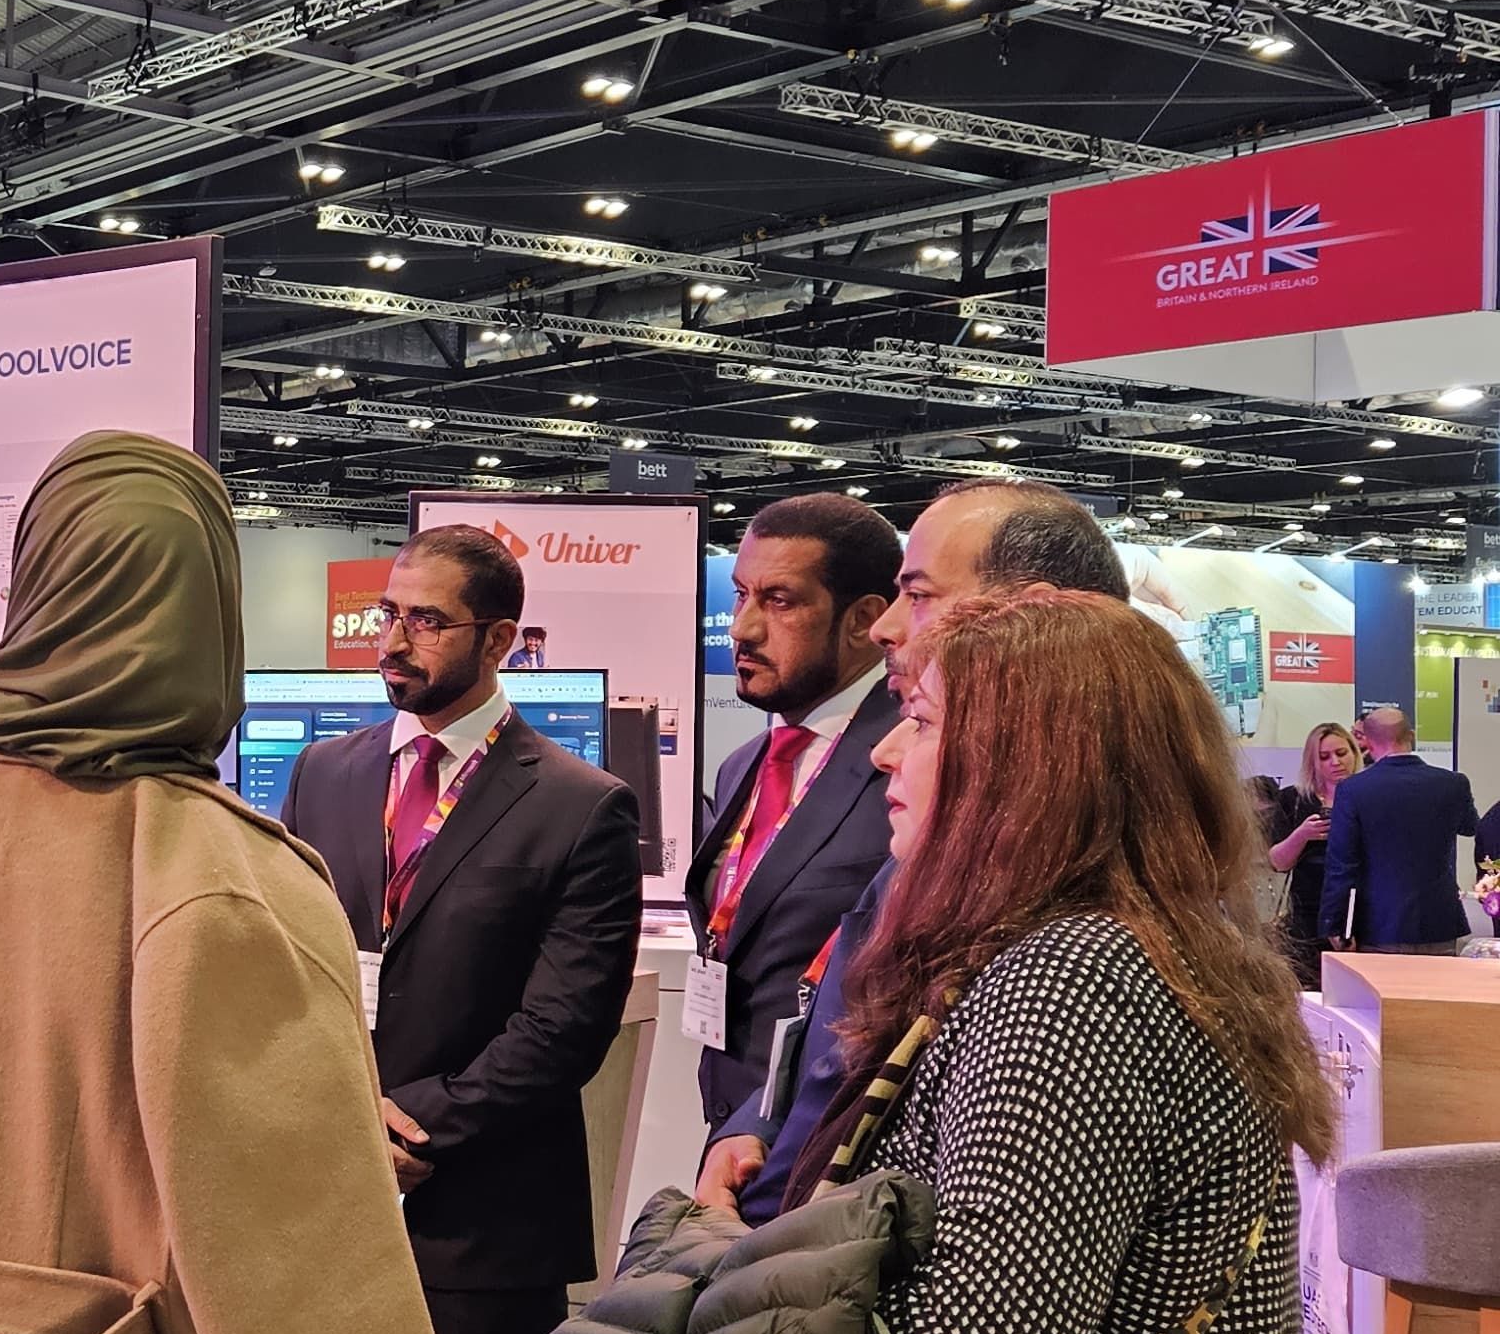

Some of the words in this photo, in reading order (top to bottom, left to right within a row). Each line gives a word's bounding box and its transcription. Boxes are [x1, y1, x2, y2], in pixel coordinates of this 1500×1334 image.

[1156, 251, 1254, 292] GREAT
[1156, 294, 1198, 308] BRITAIN
[1200, 292, 1207, 302] &
[1208, 283, 1268, 300] NORTHERN
[1270, 275, 1319, 291] IRELAND
[638, 460, 667, 477] bett
[537, 532, 641, 565] Univer
[1275, 654, 1303, 667] GREAT
